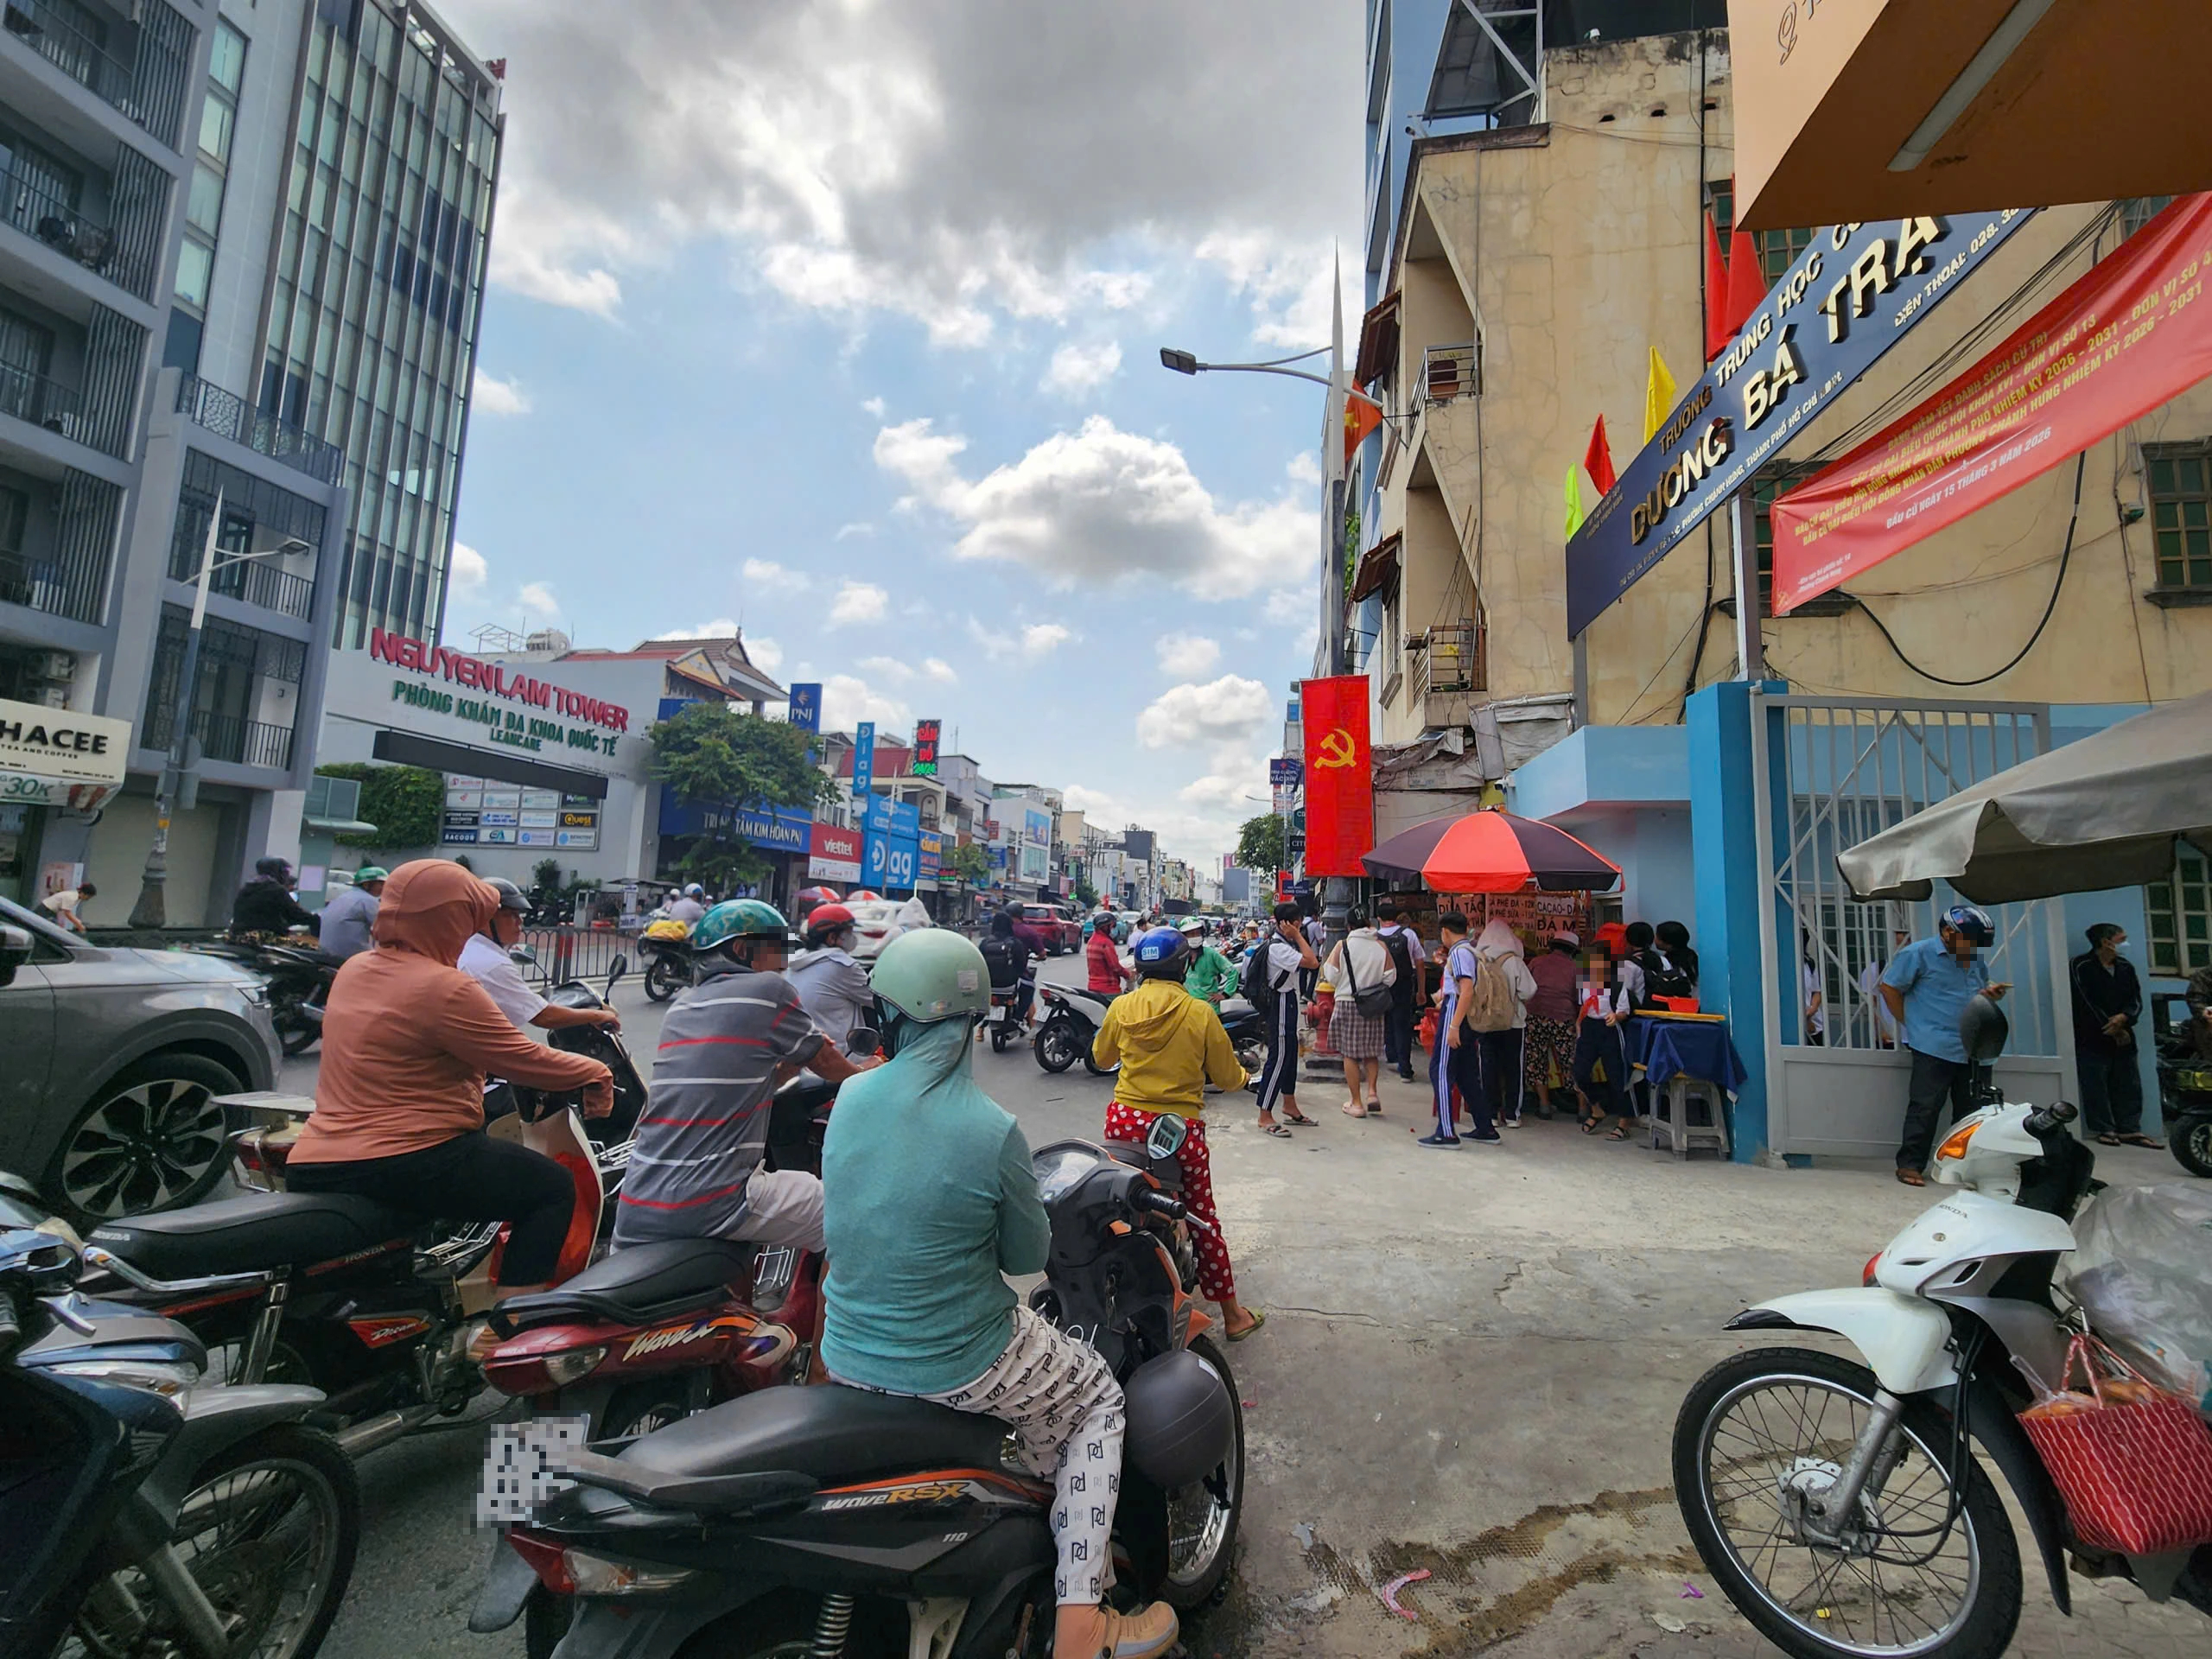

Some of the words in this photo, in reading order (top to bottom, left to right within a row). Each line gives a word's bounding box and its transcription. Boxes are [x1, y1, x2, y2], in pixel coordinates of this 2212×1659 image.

[1969, 222, 1999, 253] 028.
[1715, 313, 1772, 387] TRUNG
[1777, 251, 1822, 317] HỌC
[2082, 314, 2097, 334] 13
[2046, 353, 2076, 381] 2026
[2087, 323, 2118, 351] 2031
[2063, 359, 2102, 391] NHIỆM
[2123, 318, 2155, 349] 2026
[2169, 281, 2202, 316] 2031
[1630, 416, 1728, 545] DƯƠNG
[1744, 324, 1798, 430] BÁ
[1943, 486, 1955, 499] 15
[1990, 461, 1997, 473] 3
[2024, 426, 2052, 452] 2026
[391, 679, 453, 714] PHÒNG
[454, 700, 501, 727] KHÁM
[505, 711, 524, 734] ĐA
[530, 717, 564, 743] KHOA
[567, 728, 599, 753] QUỐC
[601, 734, 620, 757] TẾ
[553, 686, 628, 732] TOWER
[791, 708, 813, 722] PNJ
[45, 750, 79, 760] COFFEE
[735, 814, 752, 836] TÂM
[753, 820, 769, 838] KIM
[770, 821, 790, 842] HOÀN
[790, 828, 803, 847] PNJ
[823, 838, 854, 857] viettel
[1142, 947, 1159, 956] SIM
[942, 1532, 968, 1542] 110
